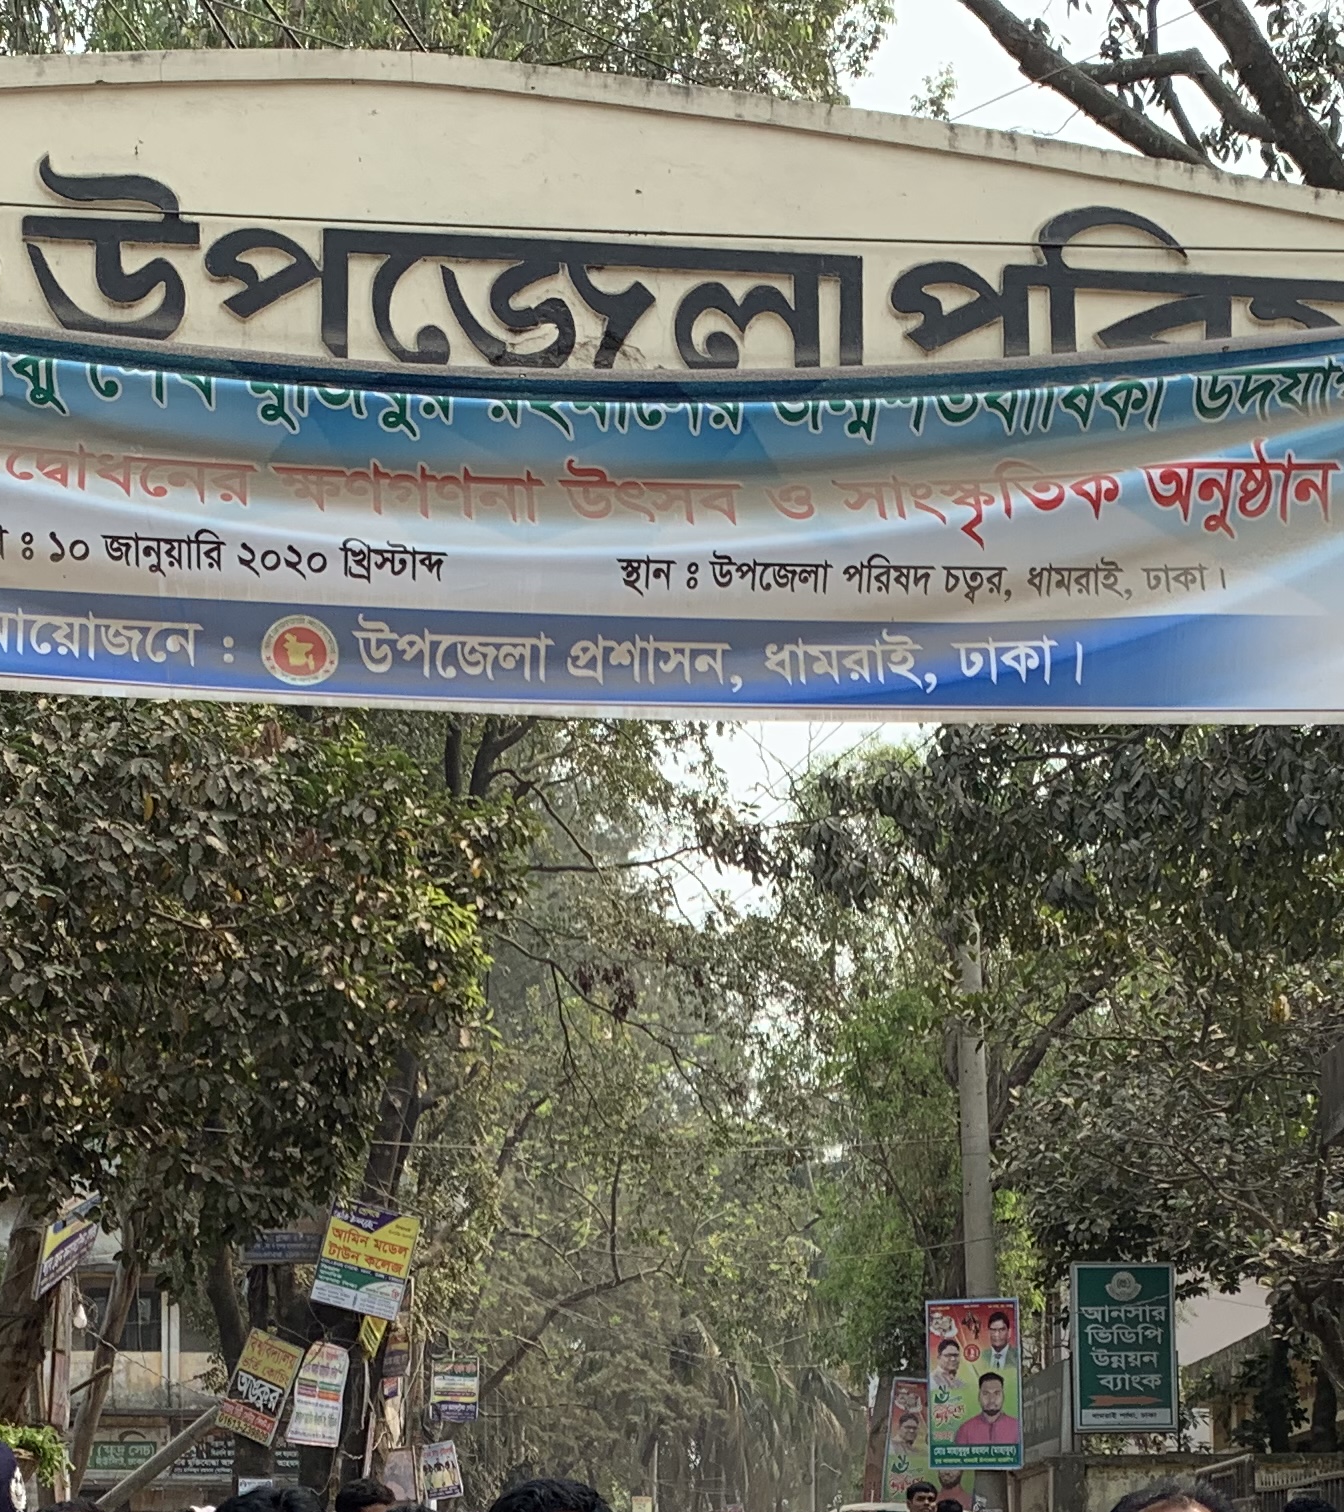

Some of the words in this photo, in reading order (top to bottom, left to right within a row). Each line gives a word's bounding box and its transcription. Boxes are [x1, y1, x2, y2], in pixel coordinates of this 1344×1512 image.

[20, 153, 864, 369] উপজেলা
[556, 456, 741, 529] উৎসব
[766, 478, 816, 521] ও
[837, 459, 1128, 549] সাংস্কৃতিক
[1140, 437, 1341, 539] অনুষ্ঠান
[49, 531, 90, 565] ১০
[101, 528, 226, 578] জানুয়ারি
[238, 541, 327, 580] ২০২০
[618, 553, 672, 600] স্থান
[709, 552, 831, 595] উপজেলা
[841, 552, 936, 597] পরিষদ
[1026, 556, 1133, 600] ধামরাই,
[352, 615, 553, 685] উপজেলা
[565, 636, 745, 695] প্রশাসন,
[762, 628, 937, 695] ধামরাই,
[328, 1241, 363, 1263] টাউন
[364, 1254, 406, 1276] কলেজ
[332, 1226, 370, 1248] আমিন
[373, 1238, 410, 1260] মডেল
[1080, 1304, 1168, 1323] আনসার
[1084, 1323, 1165, 1346] ভিডিপি
[1089, 1346, 1160, 1371] উন্নয়ন
[1096, 1372, 1163, 1392] ব্যাংক
